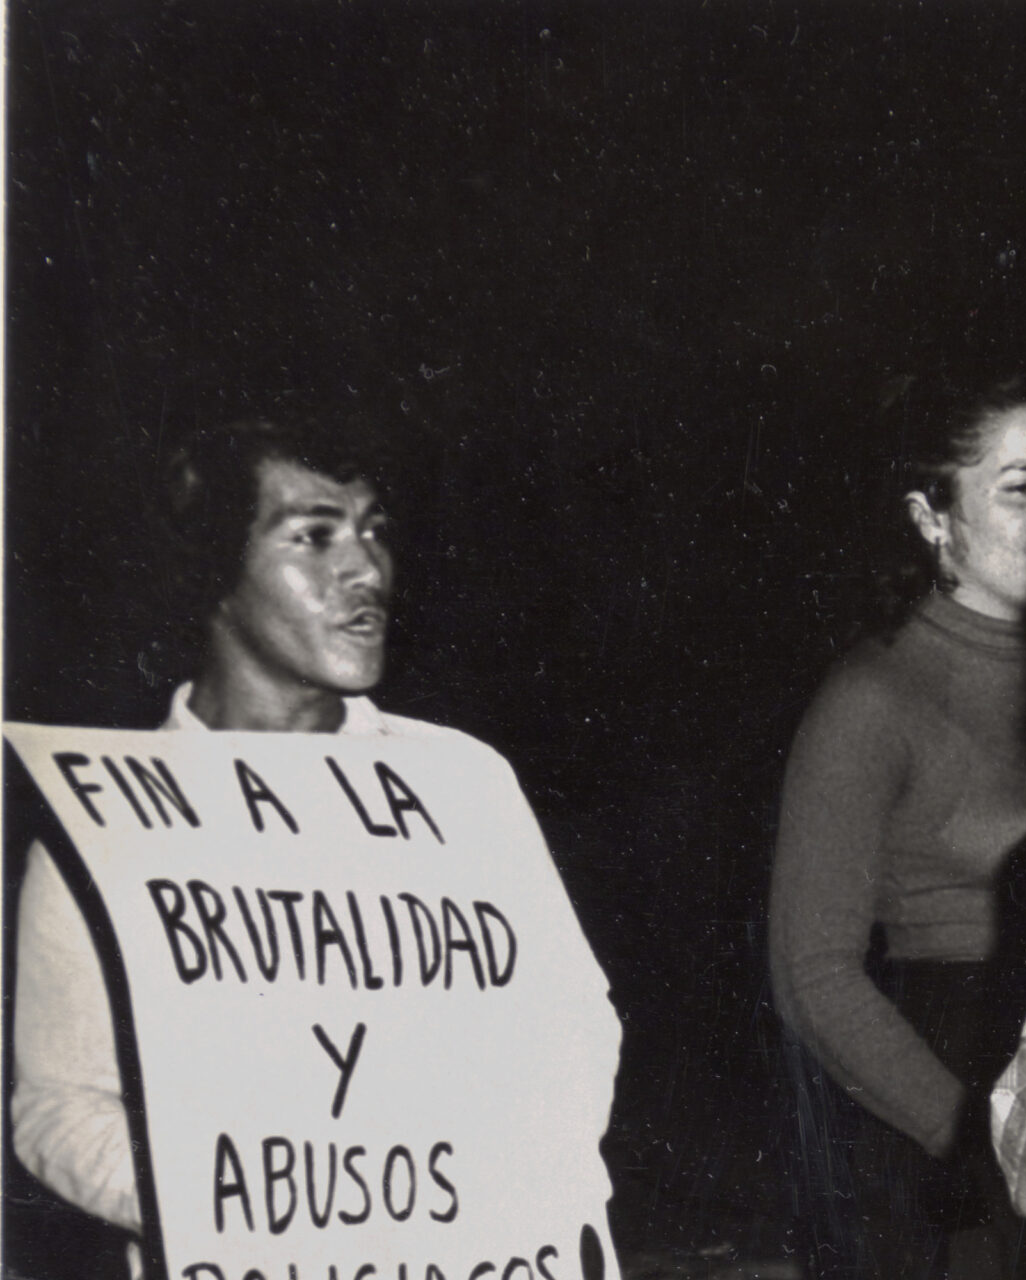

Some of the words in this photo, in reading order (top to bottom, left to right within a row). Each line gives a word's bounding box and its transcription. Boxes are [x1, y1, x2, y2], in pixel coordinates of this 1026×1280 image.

[52, 752, 202, 829] FIN
[233, 758, 299, 835] A
[324, 756, 446, 844] LA
[145, 878, 518, 990] BRUTALIDAD
[312, 1023, 367, 1119] Y
[214, 1133, 458, 1235] ABUSOS
